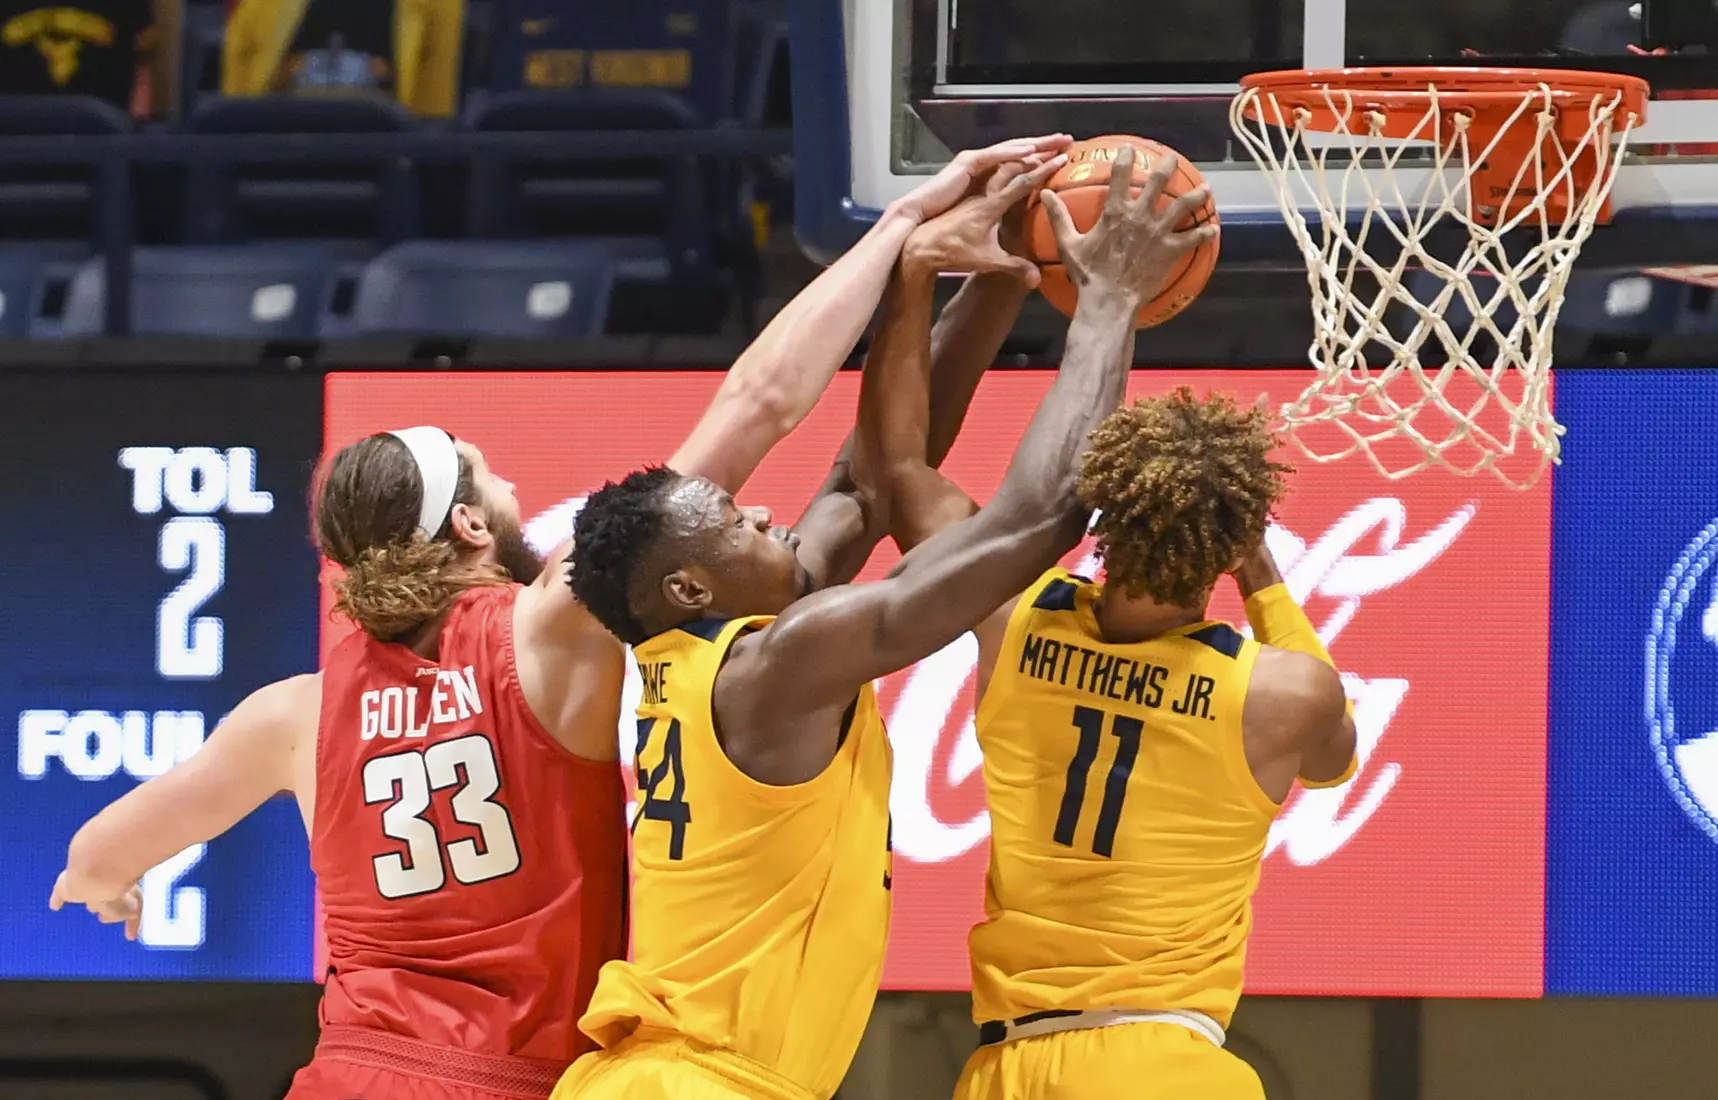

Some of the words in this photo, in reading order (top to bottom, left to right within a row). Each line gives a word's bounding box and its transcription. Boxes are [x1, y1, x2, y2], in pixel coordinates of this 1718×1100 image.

[118, 446, 275, 514] TOL
[155, 516, 226, 681] 2
[1018, 633, 1169, 709] MATTHEWS
[1171, 673, 1216, 721] JR.
[361, 733, 522, 902] 33
[1052, 704, 1145, 858] 11
